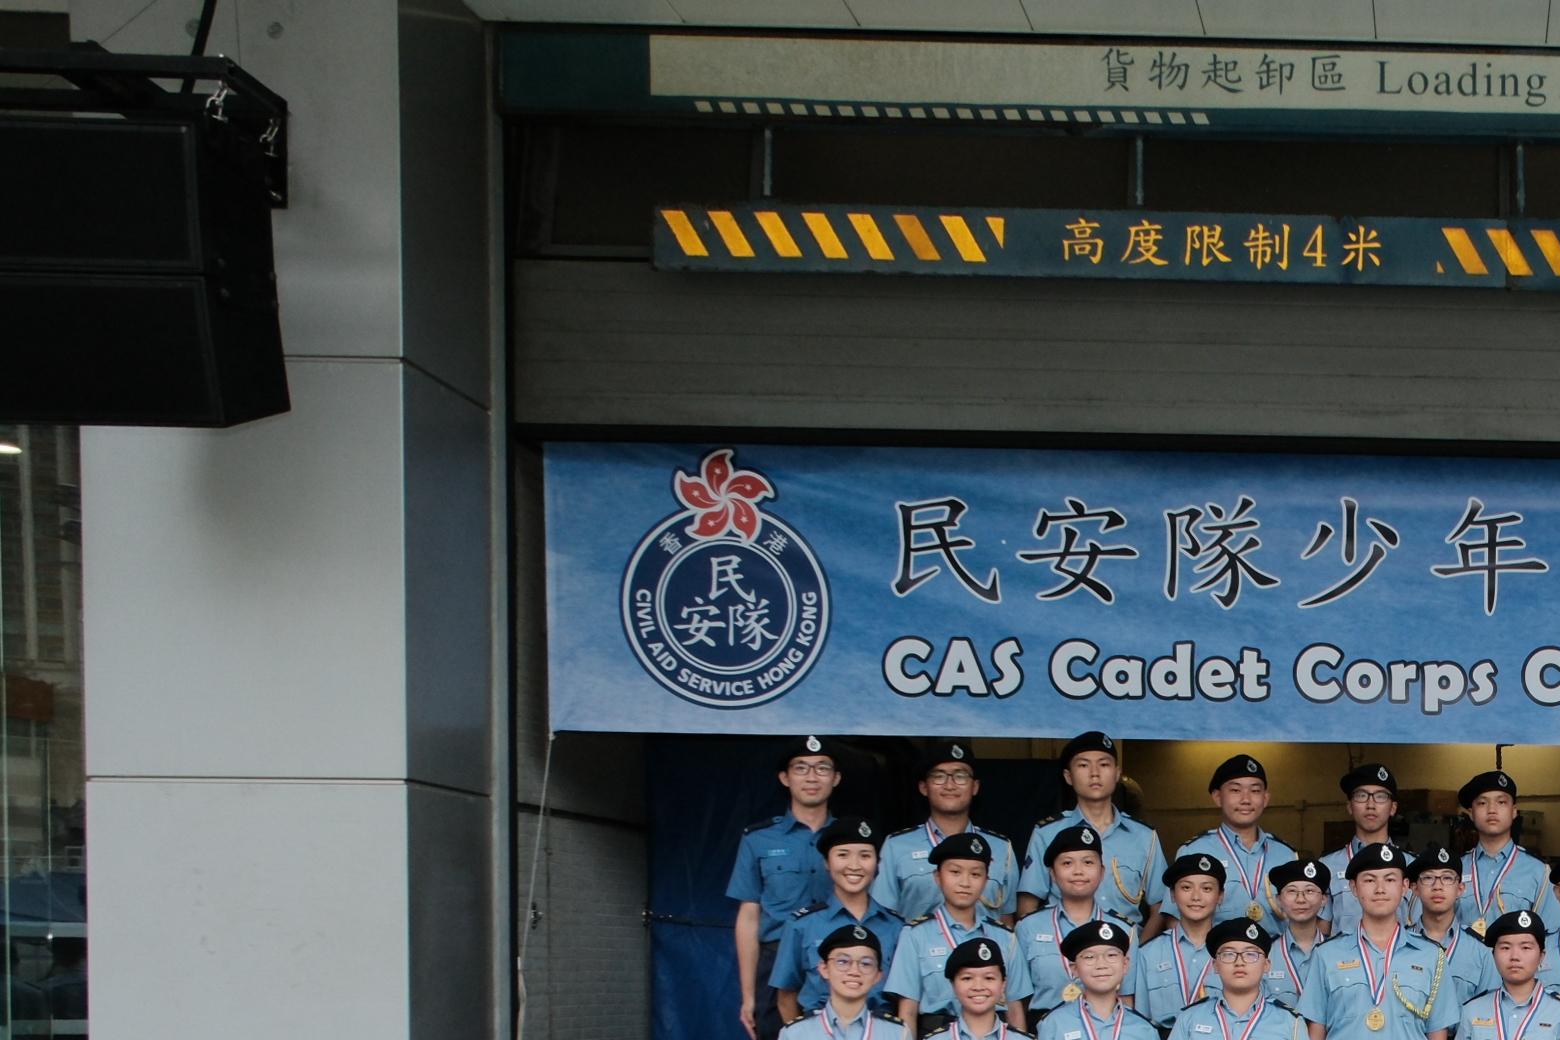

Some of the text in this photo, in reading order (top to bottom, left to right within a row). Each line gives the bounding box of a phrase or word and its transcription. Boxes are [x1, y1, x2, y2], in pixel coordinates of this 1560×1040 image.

[1102, 48, 1346, 95] 貨物起卸區
[1375, 61, 1547, 107] Loading
[1062, 218, 1382, 271] 高度限制4米
[635, 588, 818, 696] CIVIL AID SERVICE HONG KONG
[882, 635, 1024, 698] CAS
[1048, 638, 1271, 701] Cadet
[1293, 642, 1498, 715] Corps
